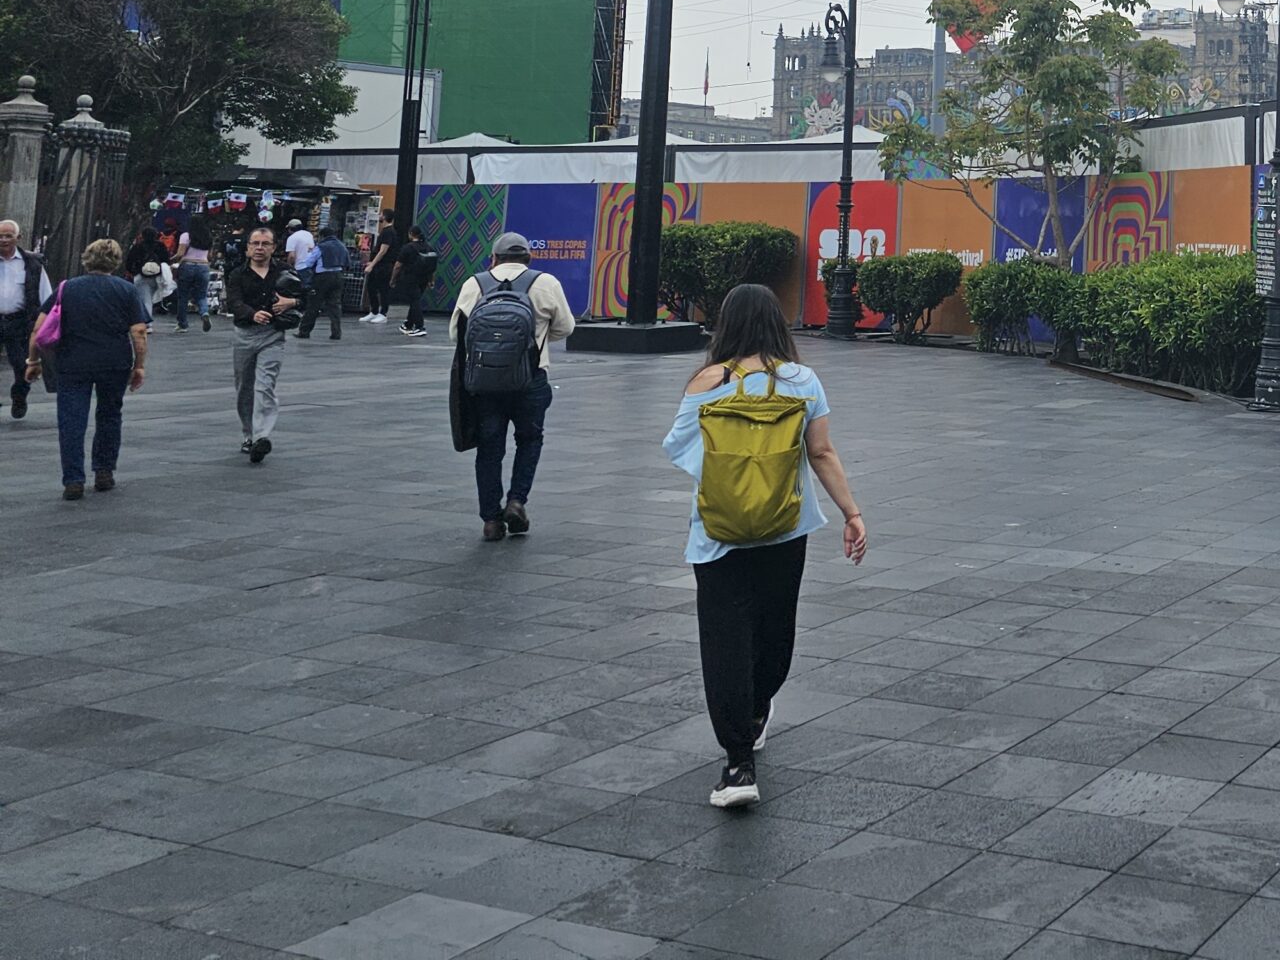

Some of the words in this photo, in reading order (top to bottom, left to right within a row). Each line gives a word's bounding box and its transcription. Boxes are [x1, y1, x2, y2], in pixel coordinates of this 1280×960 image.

[547, 240, 563, 249] TRES
[564, 240, 587, 249] COPAS
[570, 250, 586, 260] FIFA
